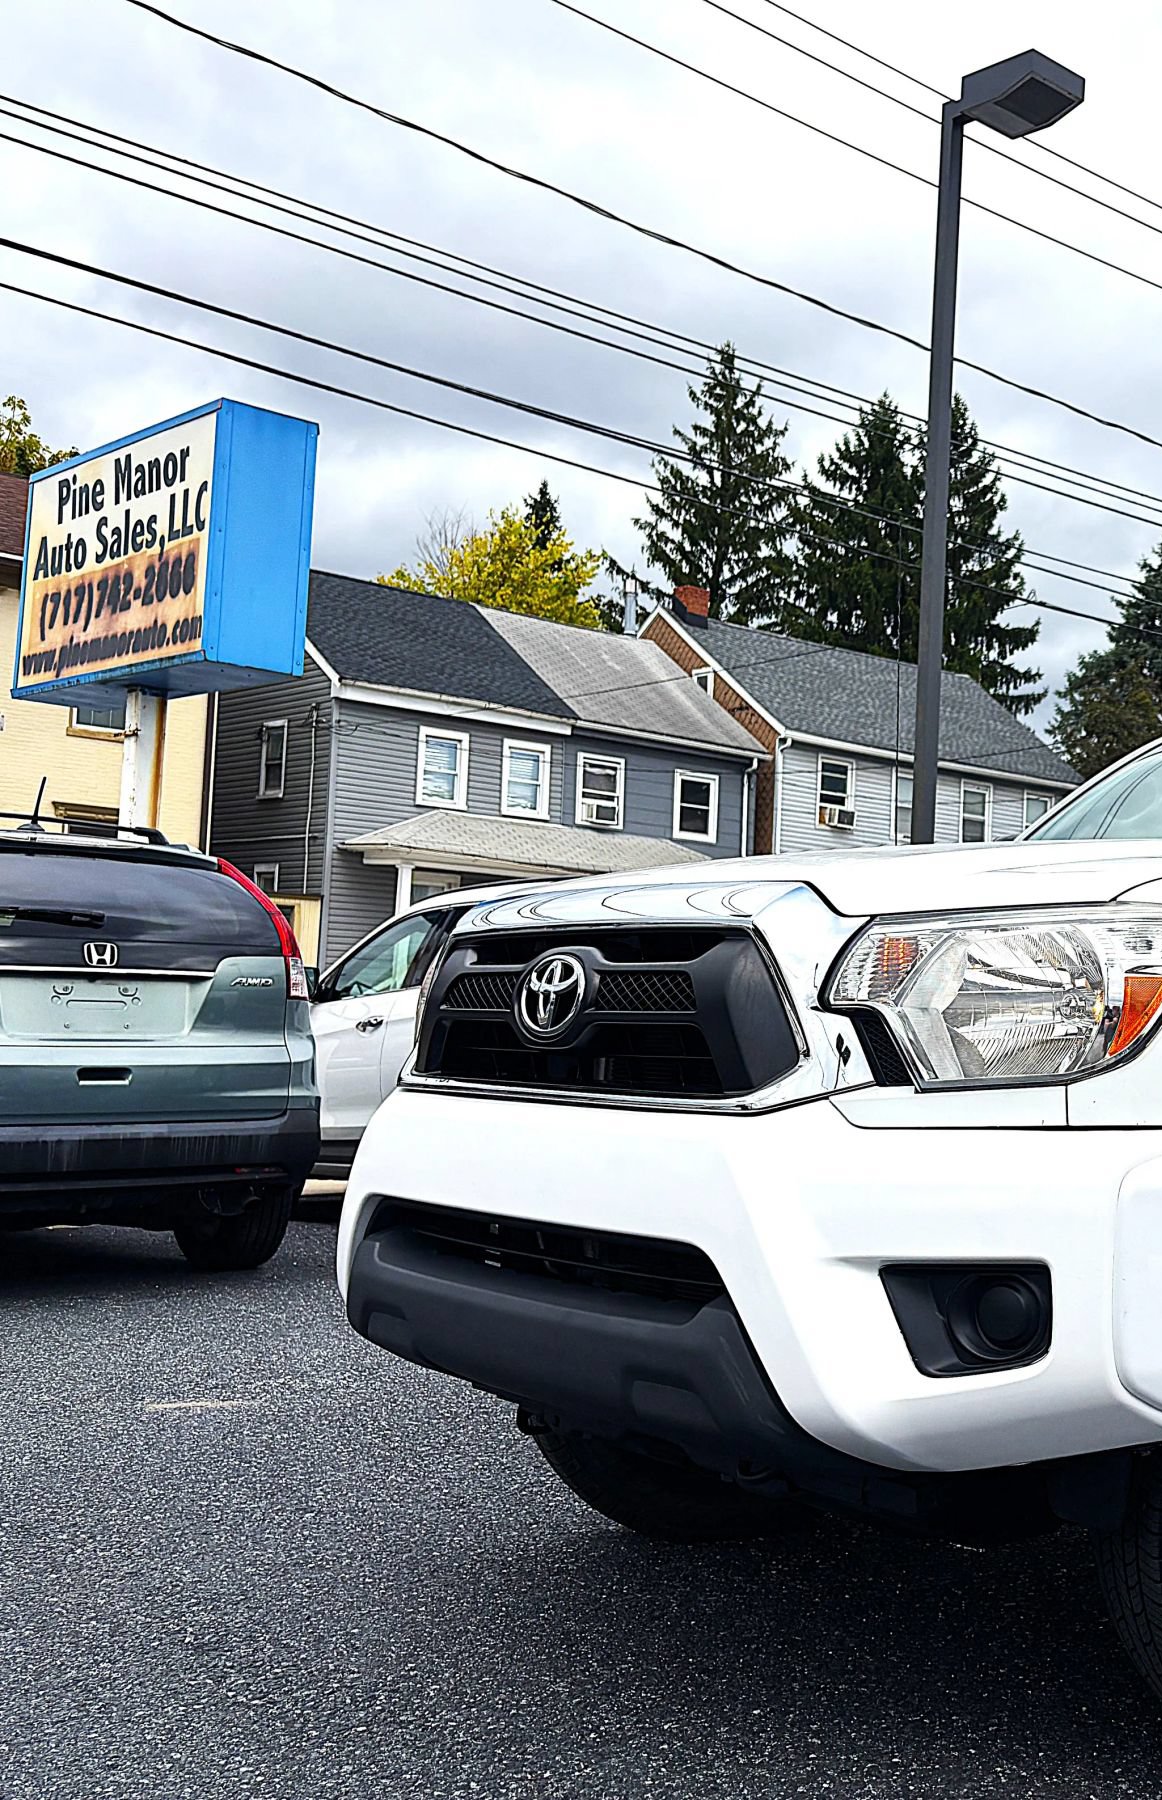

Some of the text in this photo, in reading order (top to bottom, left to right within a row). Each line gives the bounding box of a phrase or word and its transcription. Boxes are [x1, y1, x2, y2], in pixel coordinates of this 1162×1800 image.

[57, 445, 190, 525] Pine Manor
[33, 533, 87, 581] Auto
[230, 976, 273, 987] AWD
